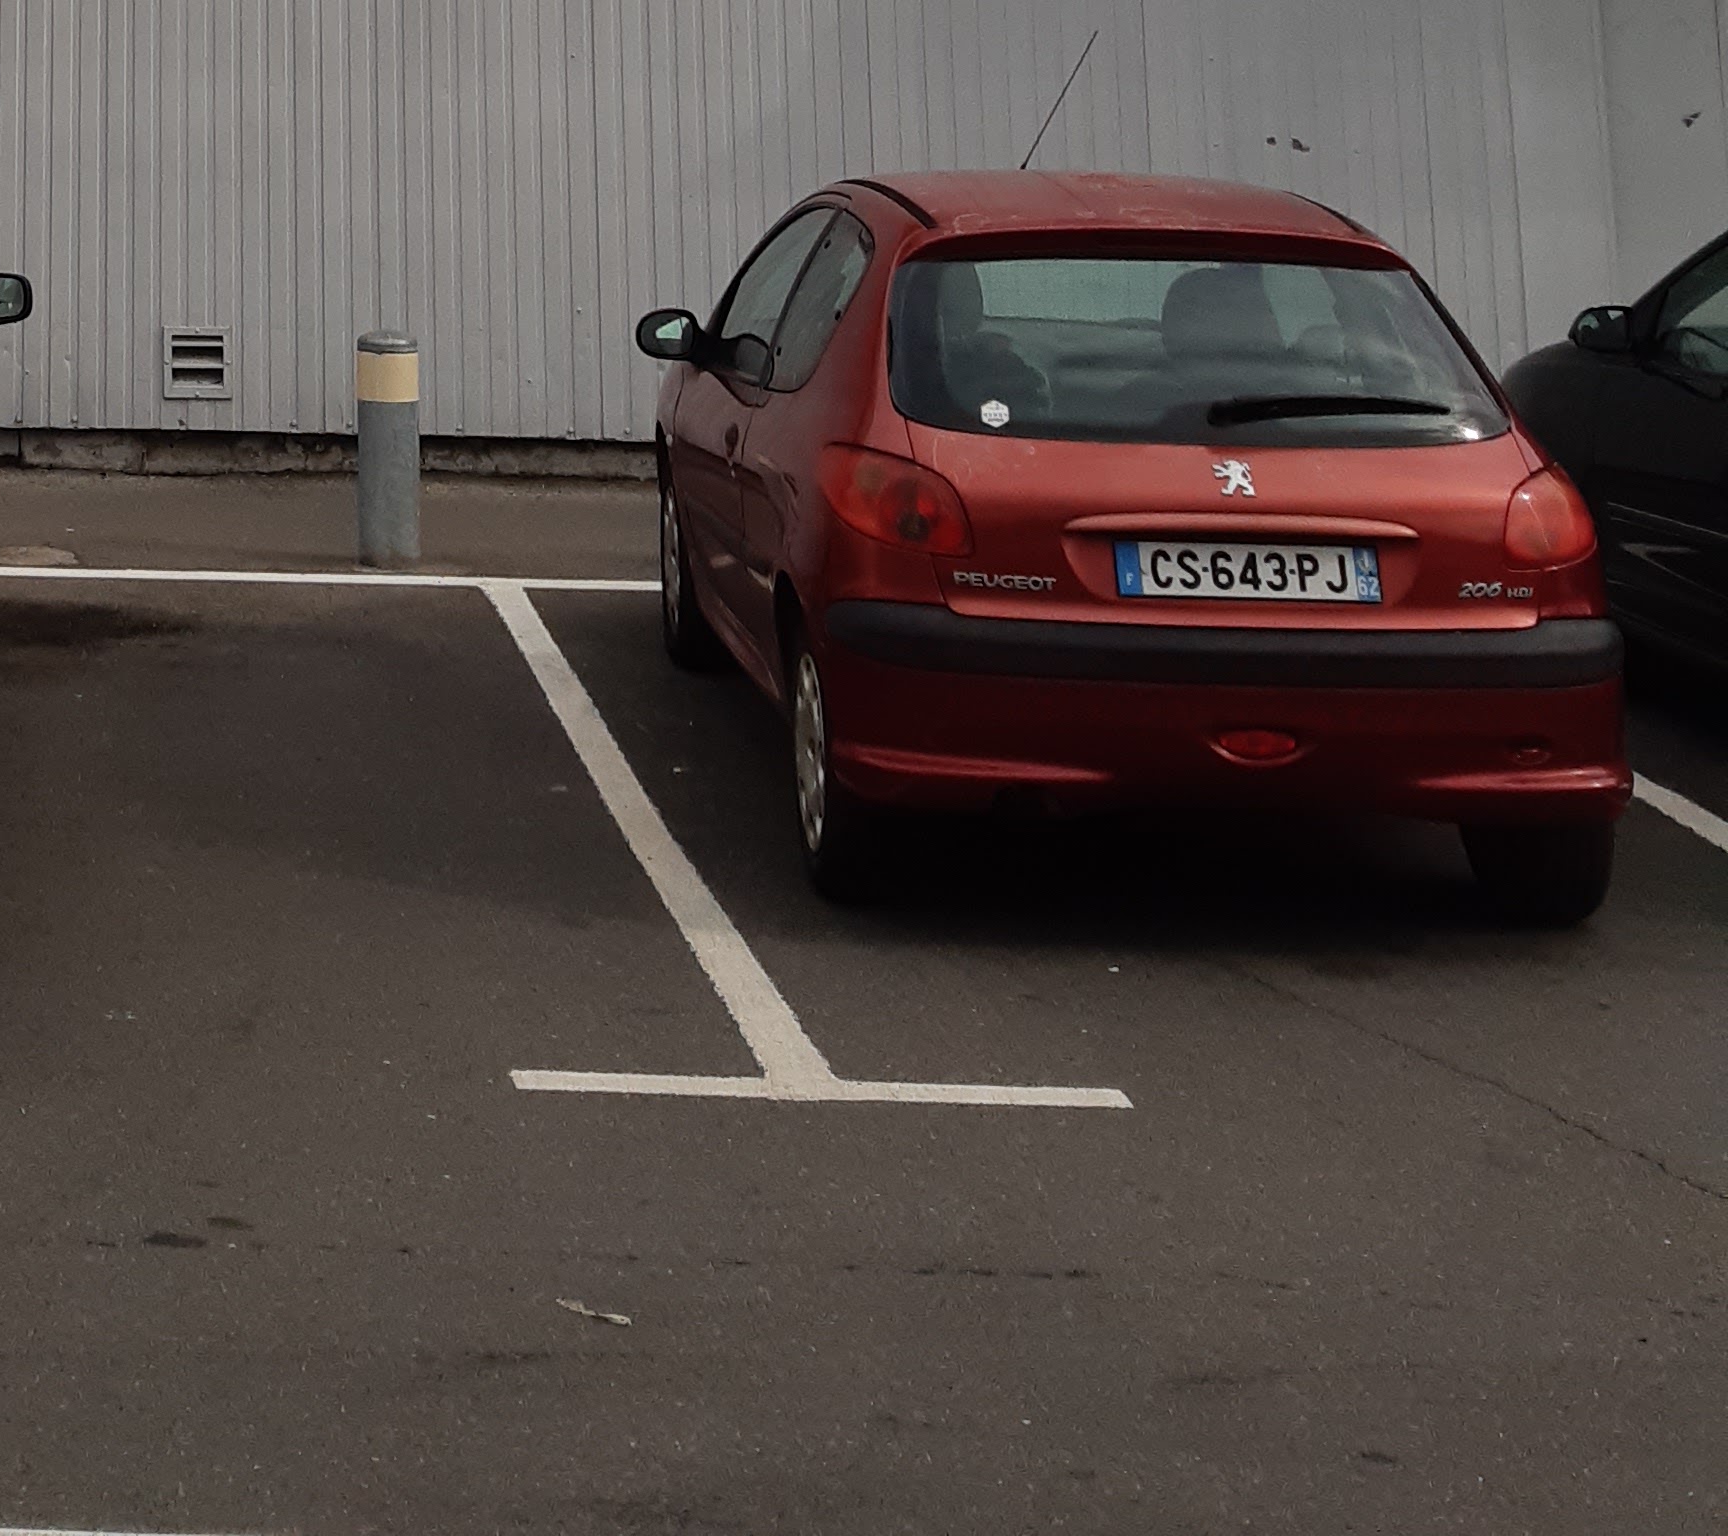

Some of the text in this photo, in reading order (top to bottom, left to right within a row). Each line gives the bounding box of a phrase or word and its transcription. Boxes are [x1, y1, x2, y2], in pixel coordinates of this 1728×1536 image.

[953, 571, 1057, 590] PEUGEOT
[1150, 549, 1349, 593] CS-643-PJ
[1358, 576, 1381, 596] 62
[1458, 582, 1503, 598] 206
